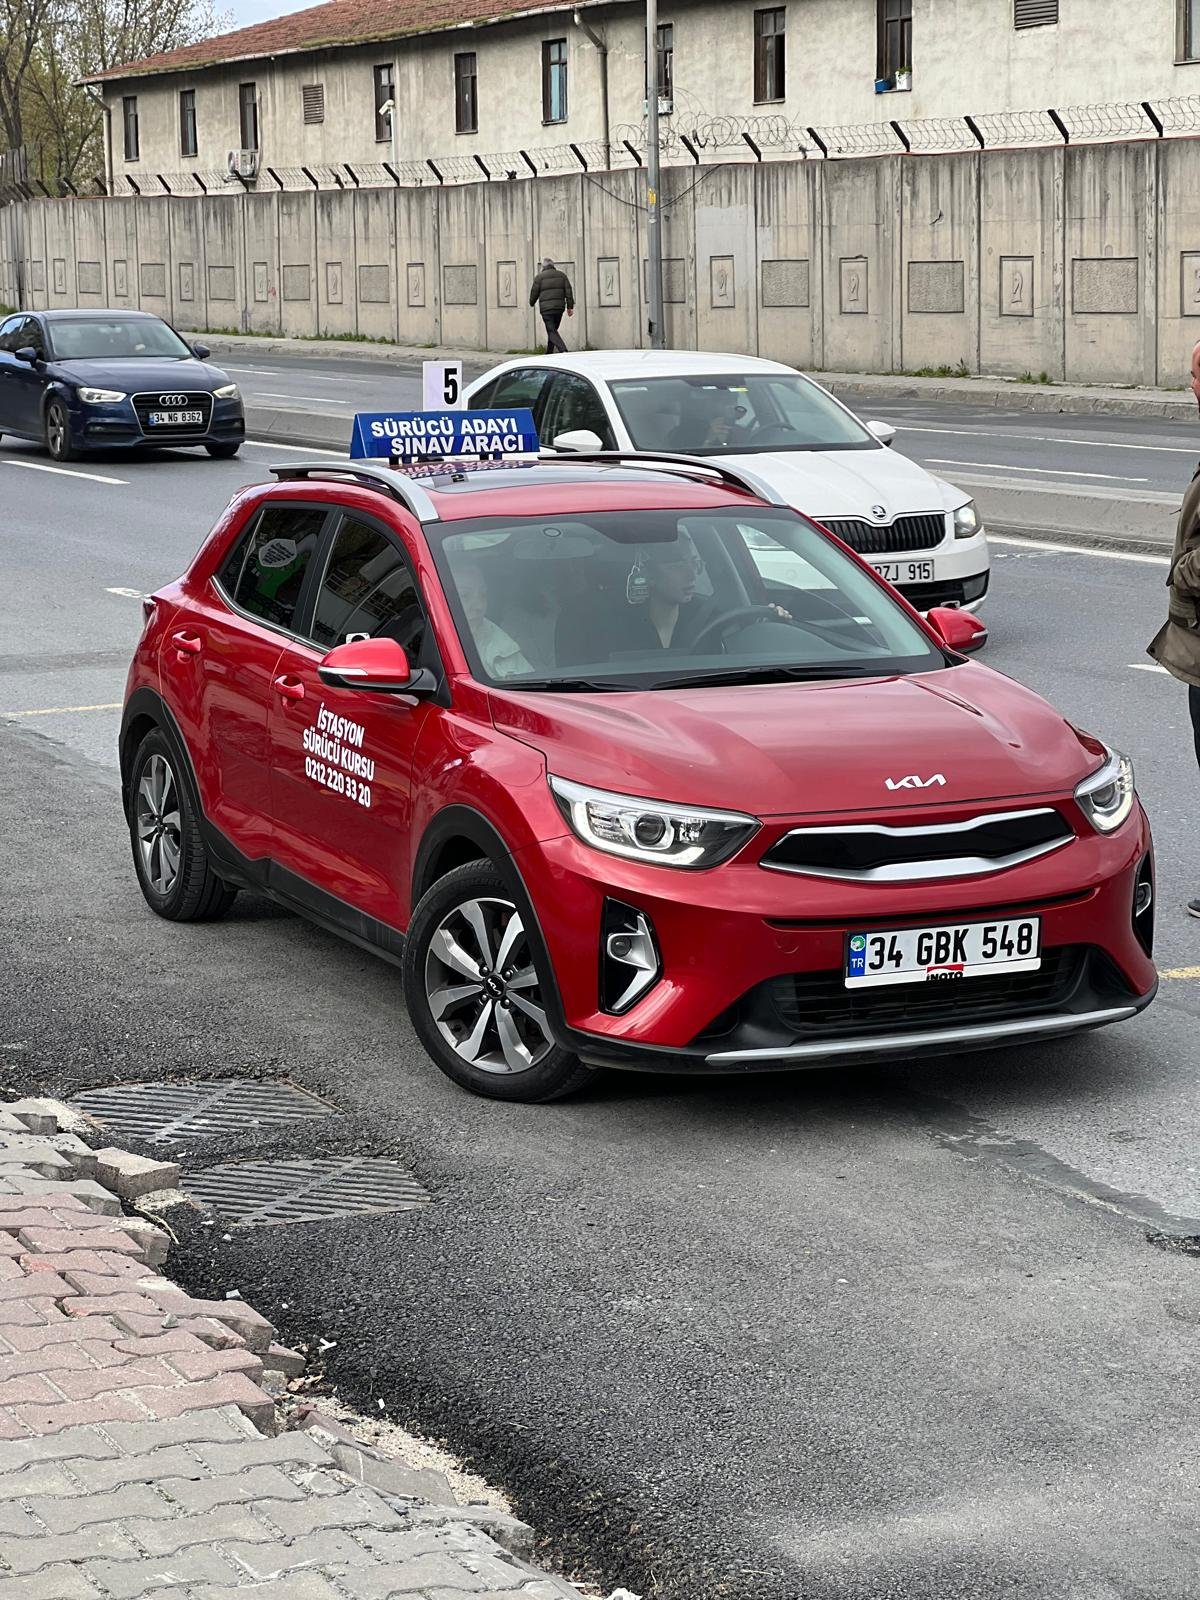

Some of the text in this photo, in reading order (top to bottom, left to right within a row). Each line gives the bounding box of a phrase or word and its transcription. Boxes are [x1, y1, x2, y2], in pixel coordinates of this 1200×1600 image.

[443, 367, 458, 405] 5
[154, 413, 165, 422] 34
[181, 412, 201, 422] 8362
[371, 416, 518, 438] SÜRÜCÜ ADAYI
[391, 434, 524, 455] SINAV ARACI
[908, 563, 930, 580] 915
[317, 701, 365, 748] İSTASYON
[303, 725, 375, 781] SÜRÜCÜ KURSU
[305, 756, 371, 808] 0212 220 33 20
[884, 773, 947, 790] KIA
[868, 922, 1033, 970] 34 GBK 548
[851, 957, 865, 969] TR
